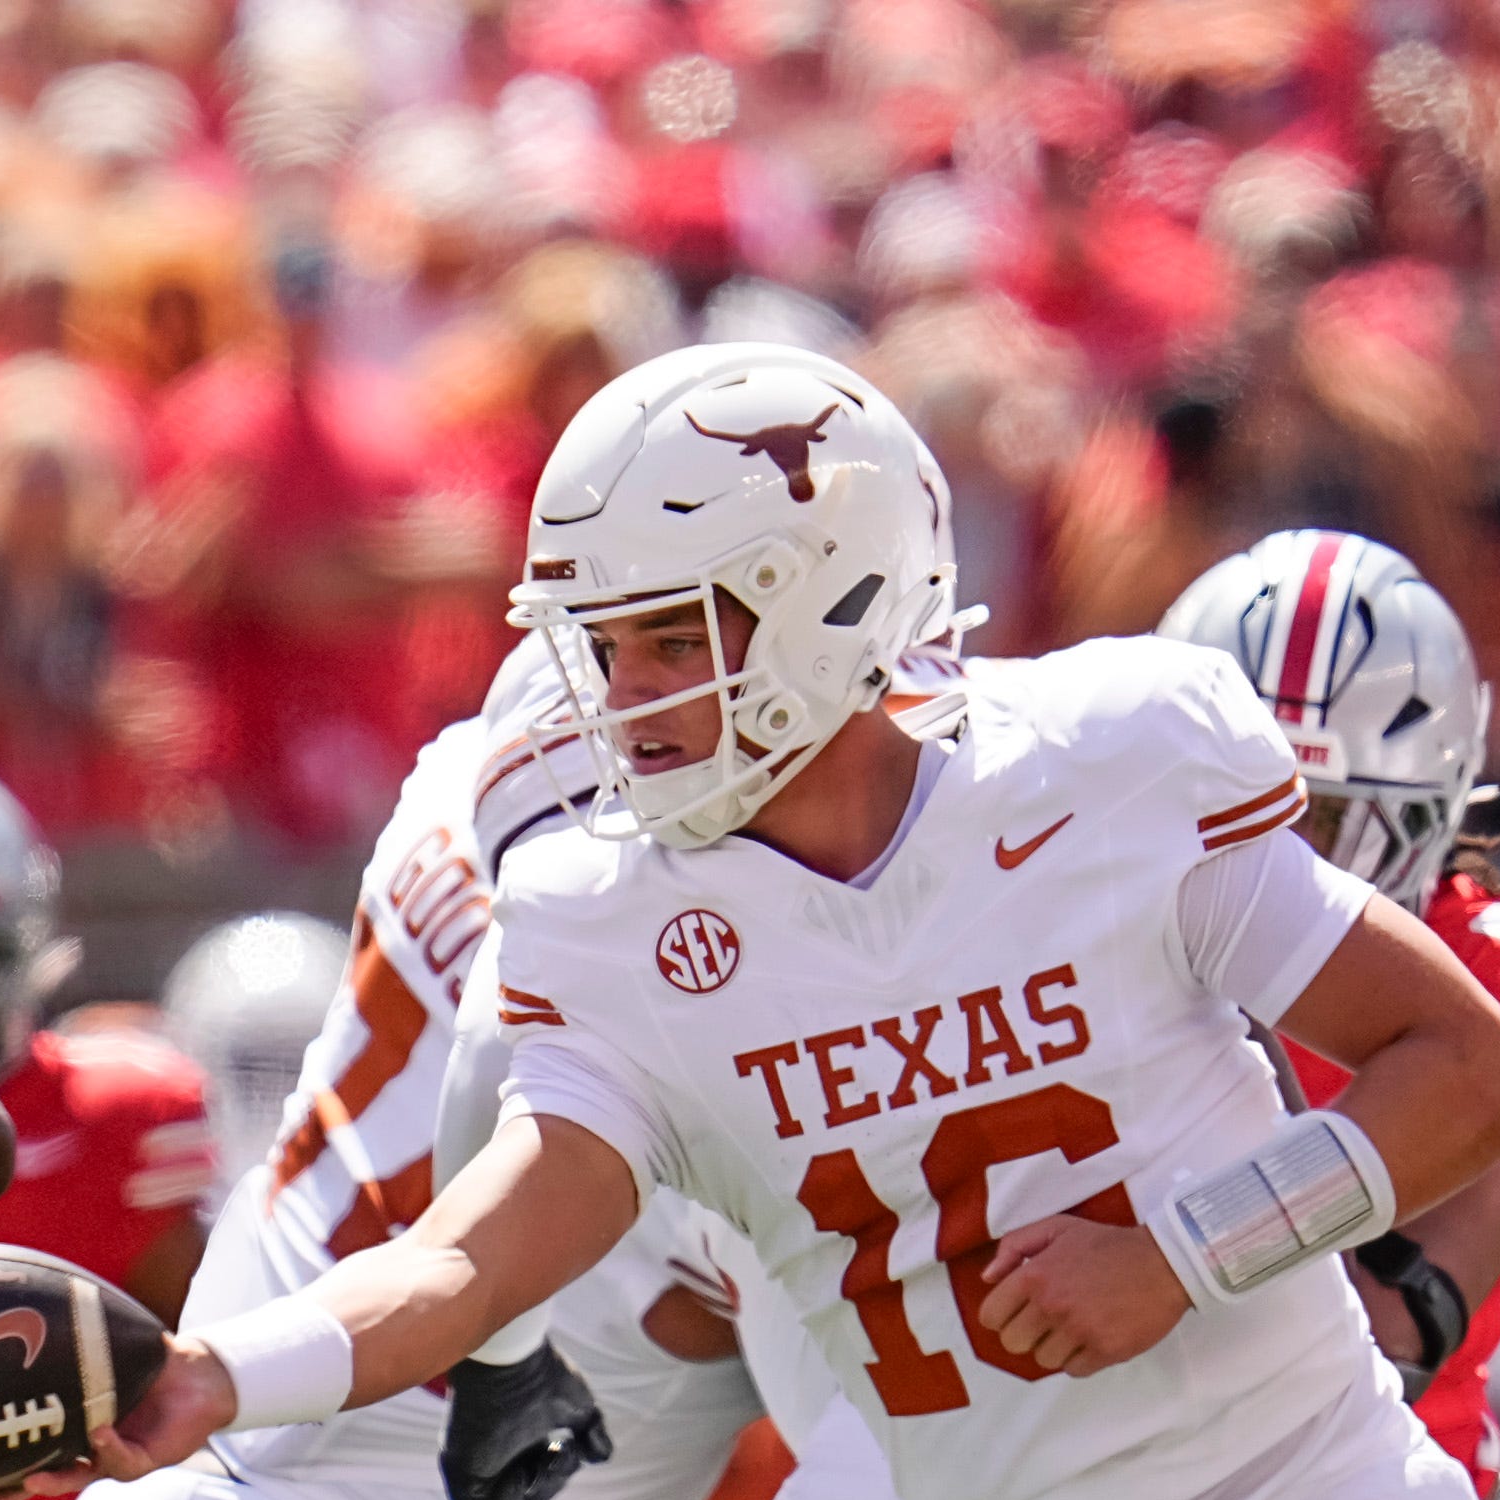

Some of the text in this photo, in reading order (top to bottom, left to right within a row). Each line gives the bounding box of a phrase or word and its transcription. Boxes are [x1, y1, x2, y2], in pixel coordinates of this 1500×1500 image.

[656, 908, 740, 994] SEC
[733, 961, 1091, 1140] TEXAS
[796, 1081, 1138, 1417] 16
